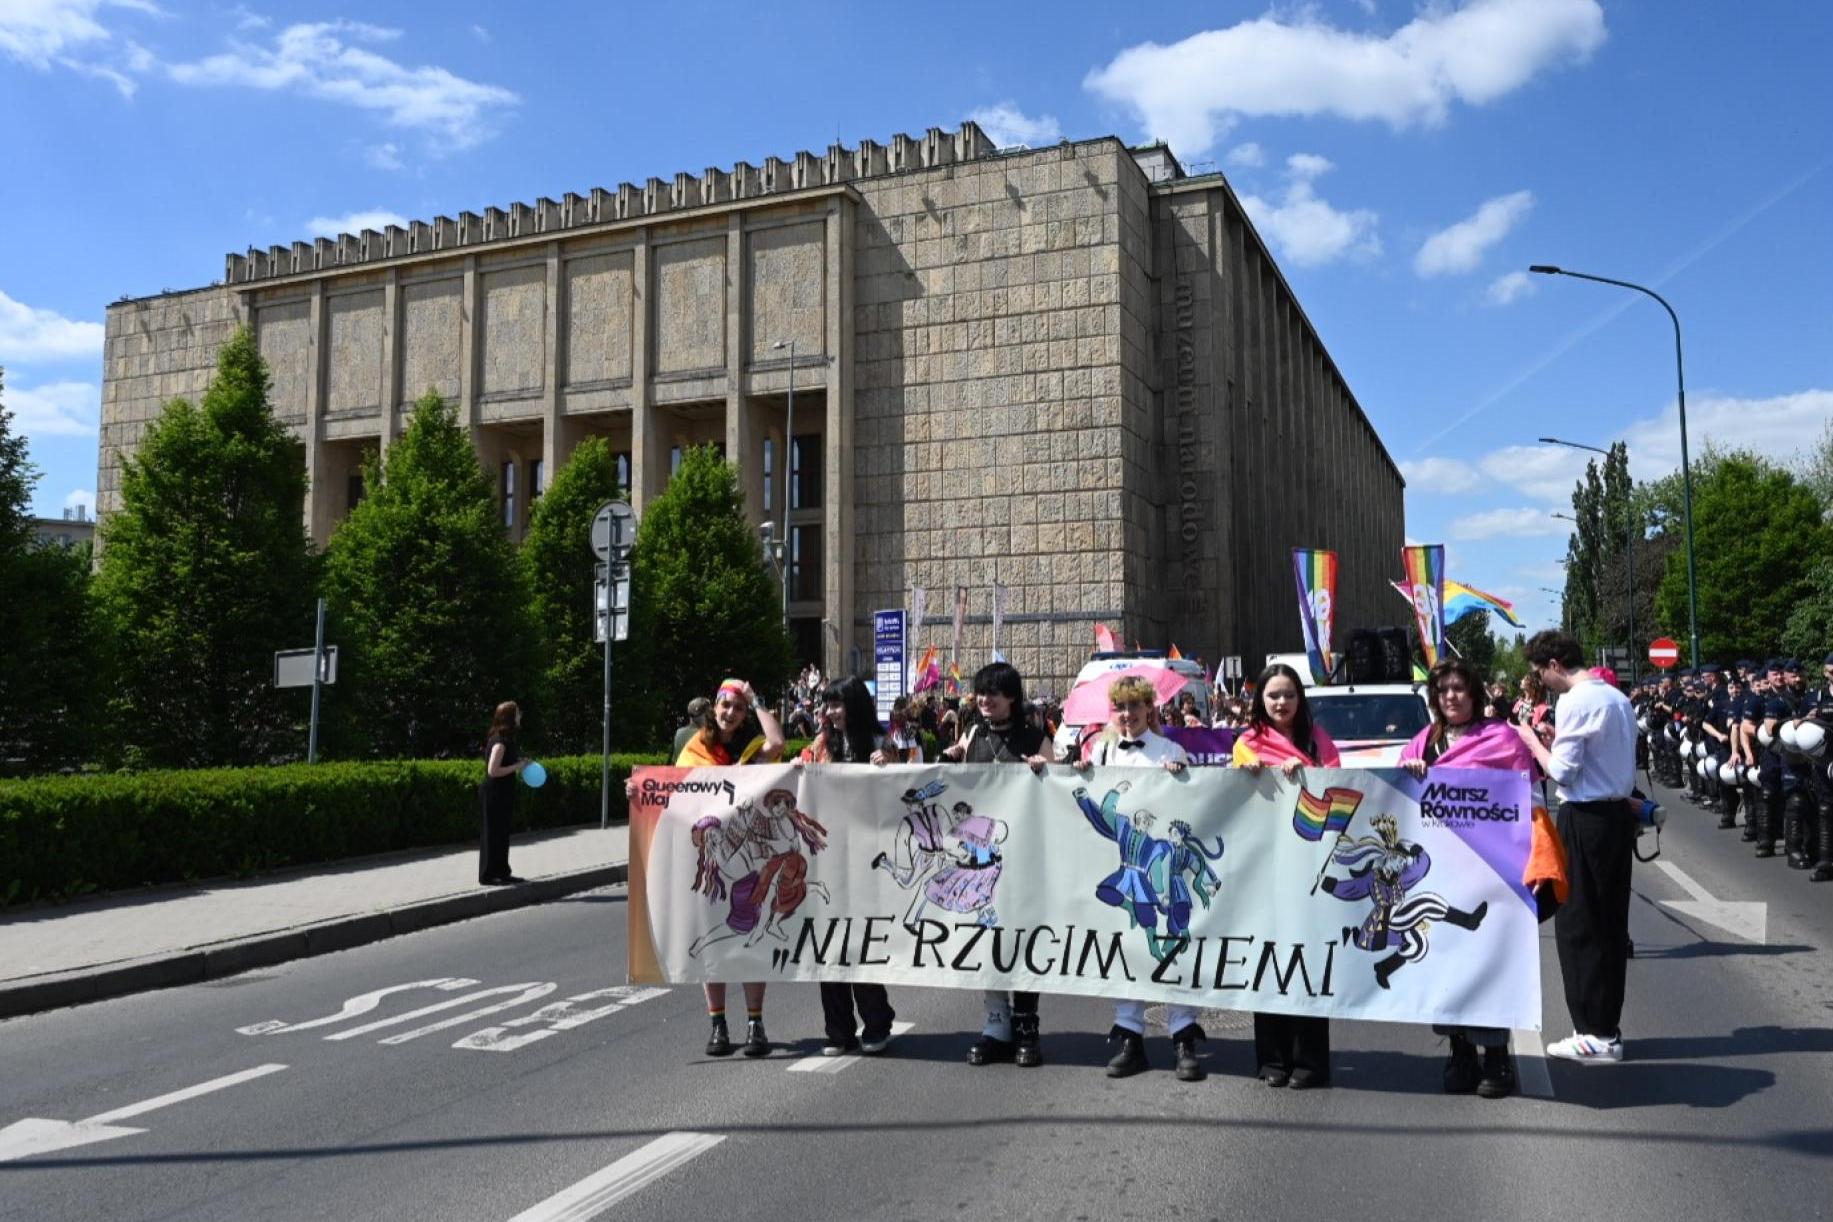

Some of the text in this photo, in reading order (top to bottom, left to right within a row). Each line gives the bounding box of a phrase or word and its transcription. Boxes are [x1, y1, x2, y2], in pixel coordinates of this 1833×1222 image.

[642, 778, 722, 796] Queerowy
[1421, 782, 1489, 802] Marsz
[640, 792, 669, 809] Maj
[1420, 800, 1519, 822] Równości
[911, 917, 1136, 982] RZUCIM
